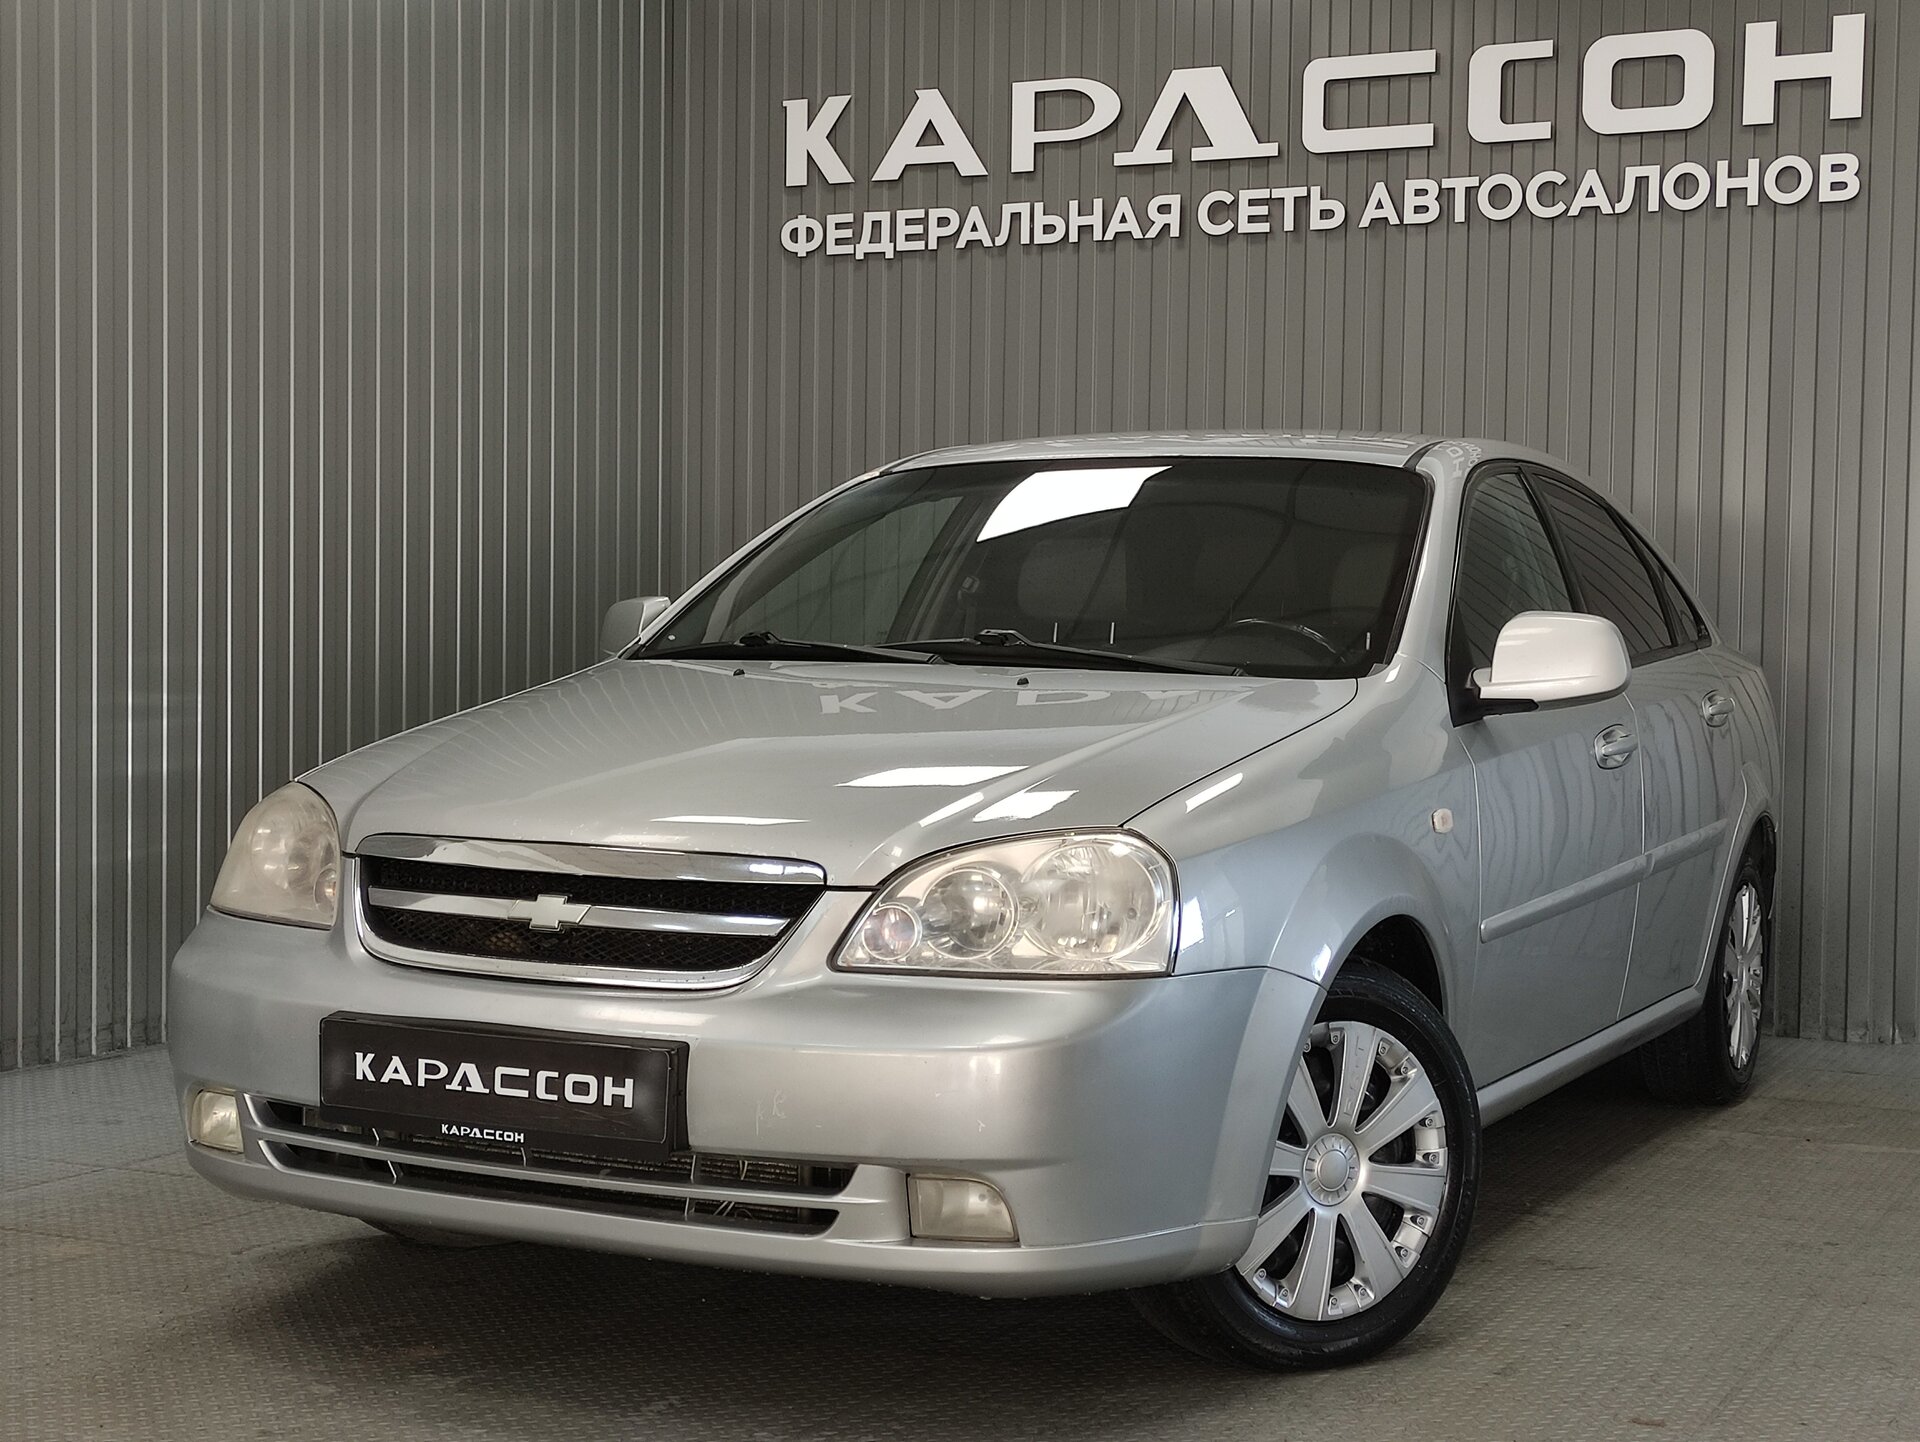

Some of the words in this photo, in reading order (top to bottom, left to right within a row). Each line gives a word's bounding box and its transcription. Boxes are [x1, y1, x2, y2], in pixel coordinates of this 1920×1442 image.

[780, 194, 1181, 260] ФЕДЕРАЛЬНАЯ
[1197, 186, 1346, 236] СЕТЬ
[1358, 152, 1861, 228] АВТОСАЛОНОВ
